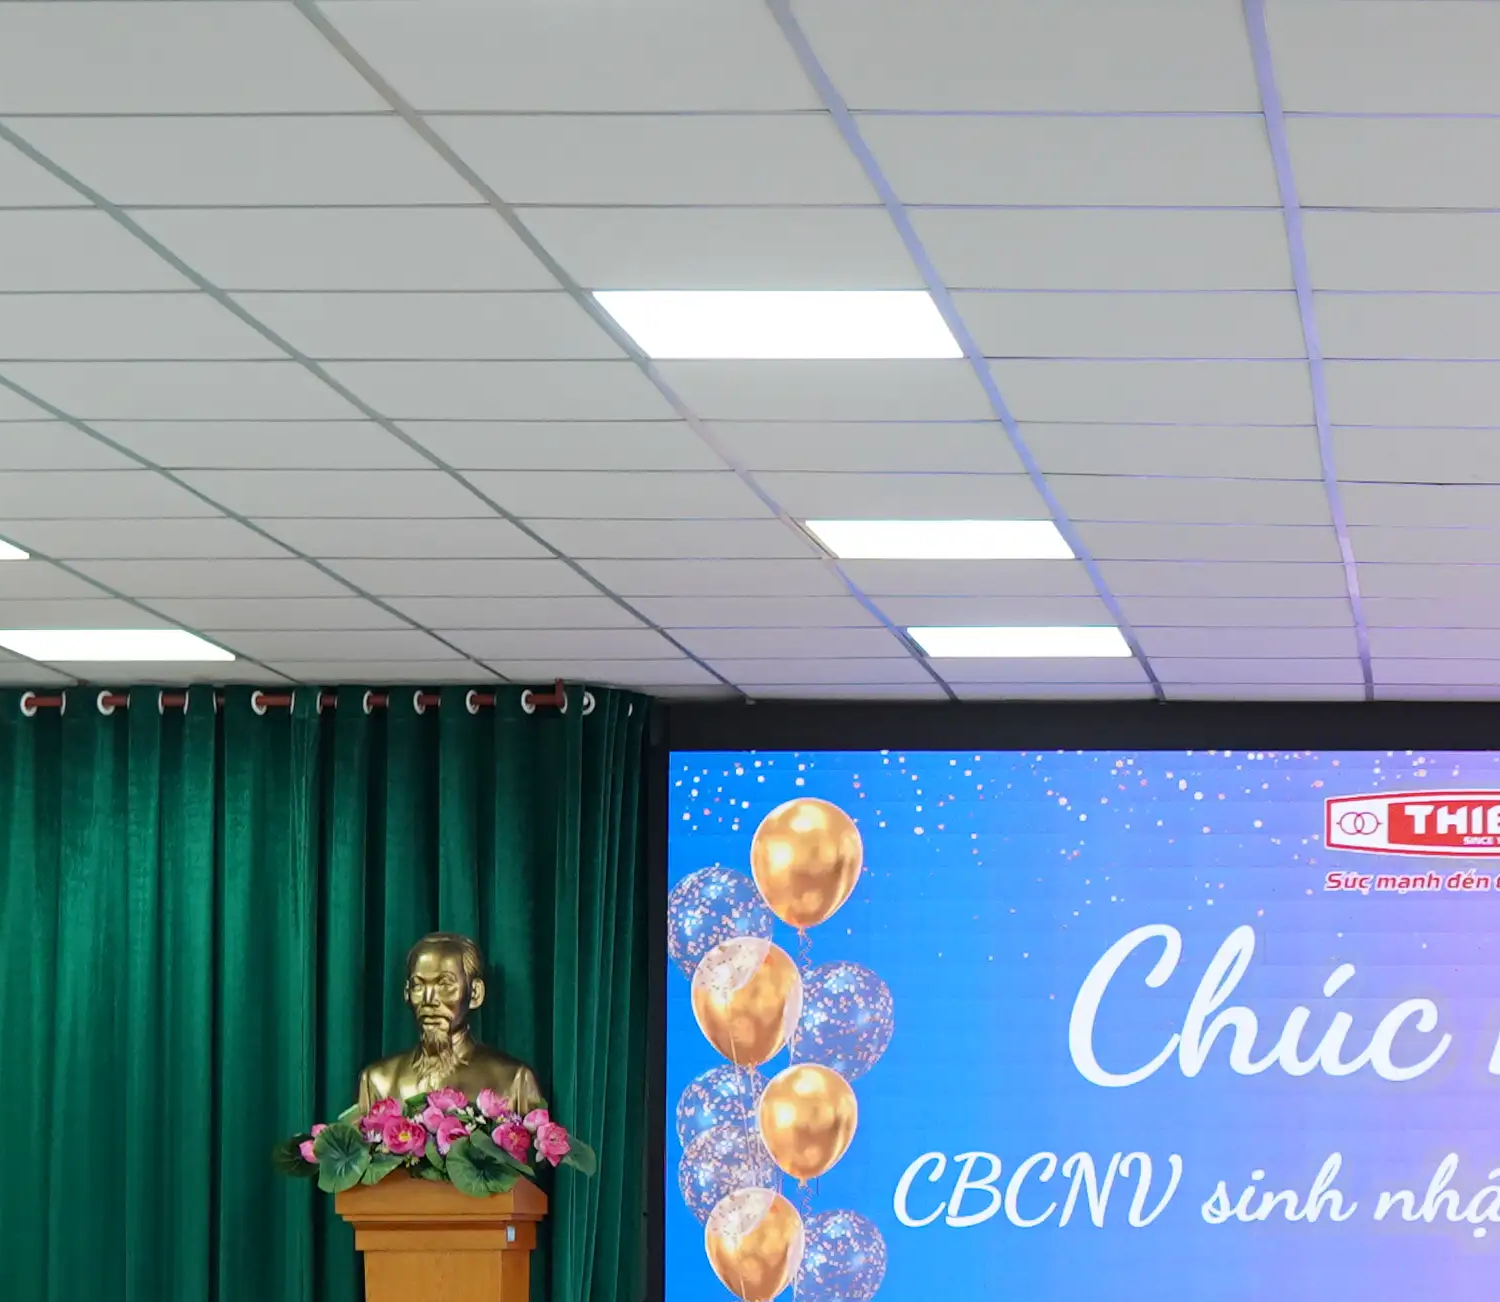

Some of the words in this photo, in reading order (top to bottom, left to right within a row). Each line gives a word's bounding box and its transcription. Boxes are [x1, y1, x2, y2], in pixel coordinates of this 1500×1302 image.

[1068, 923, 1454, 1090] Chúc
[893, 1151, 1185, 1229] CBCNV
[1200, 1153, 1357, 1226] sinh
